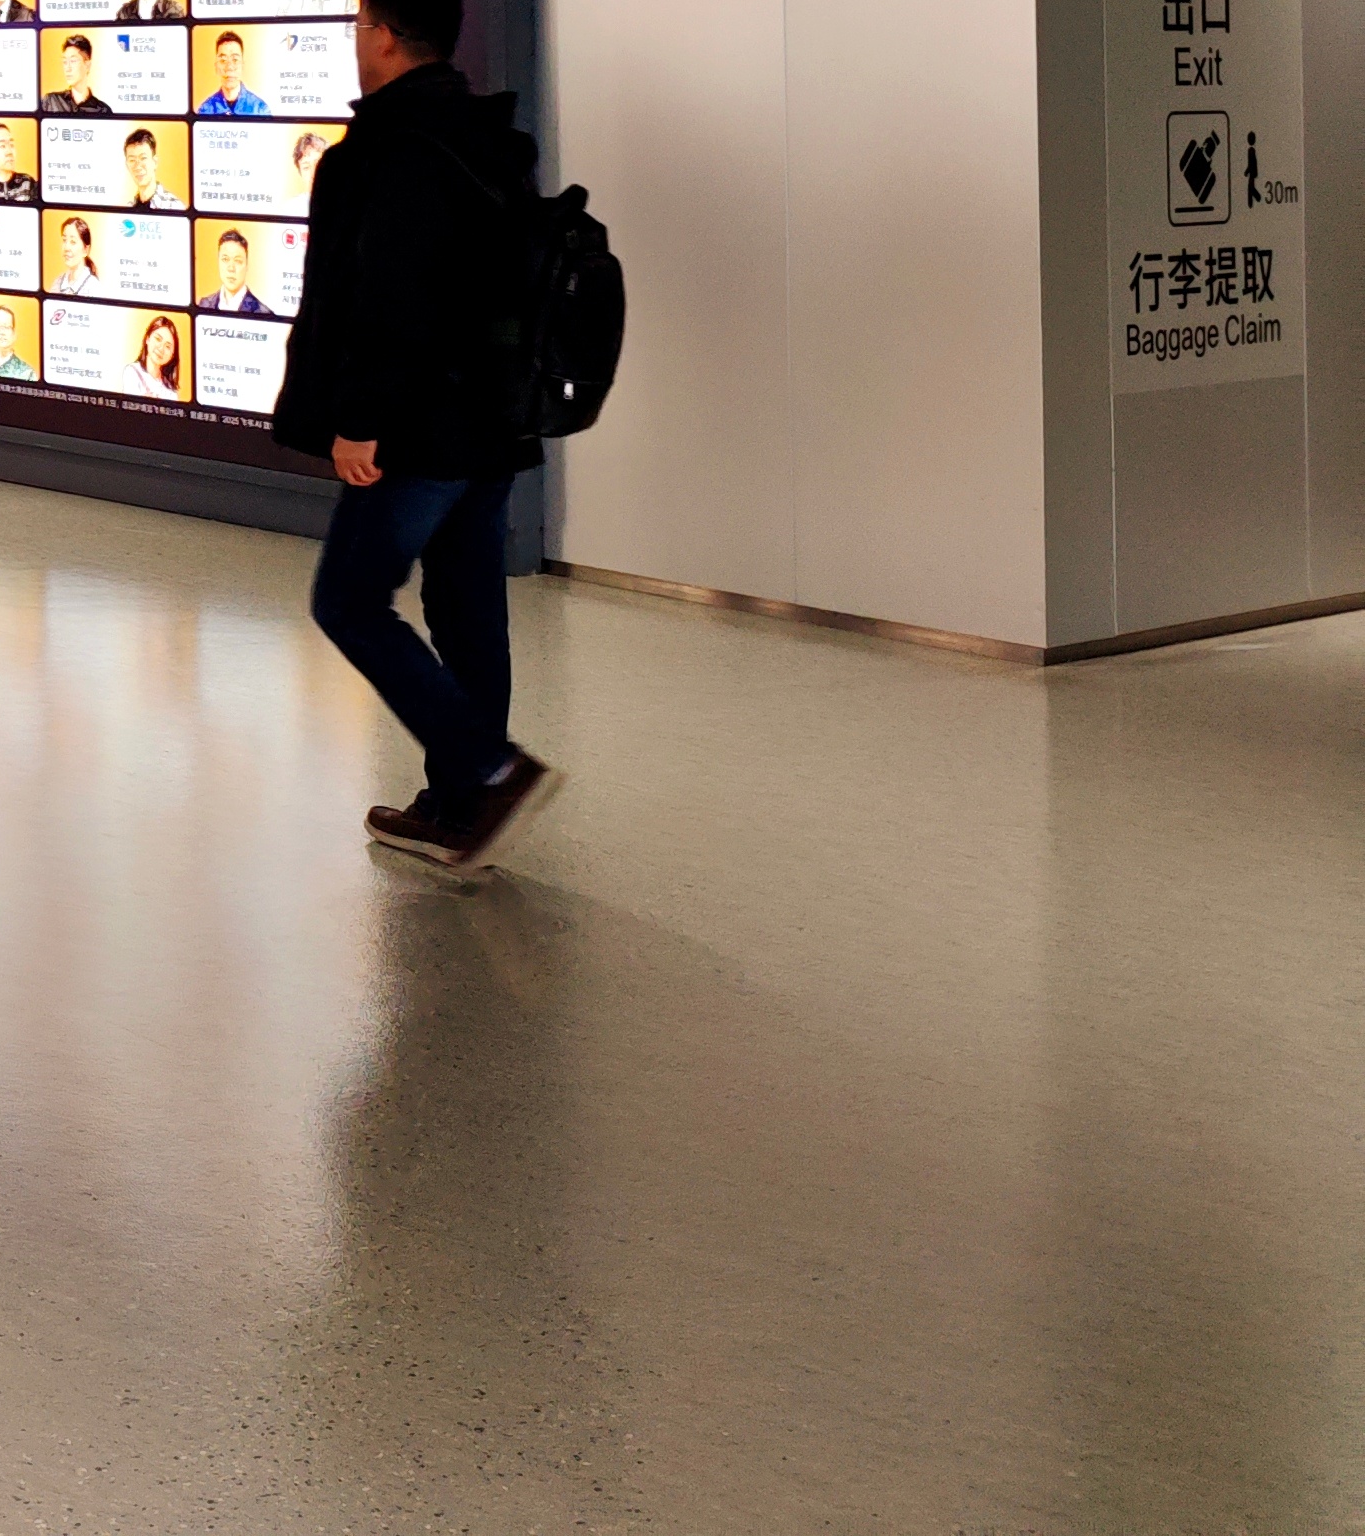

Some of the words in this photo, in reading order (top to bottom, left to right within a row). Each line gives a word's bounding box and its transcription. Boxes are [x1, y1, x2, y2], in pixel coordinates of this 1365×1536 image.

[1174, 47, 1224, 86] Exit
[1264, 181, 1299, 204] 30m
[1129, 246, 1274, 314] 行李提取
[1126, 324, 1220, 362] Baggage
[1225, 313, 1281, 347] Claim
